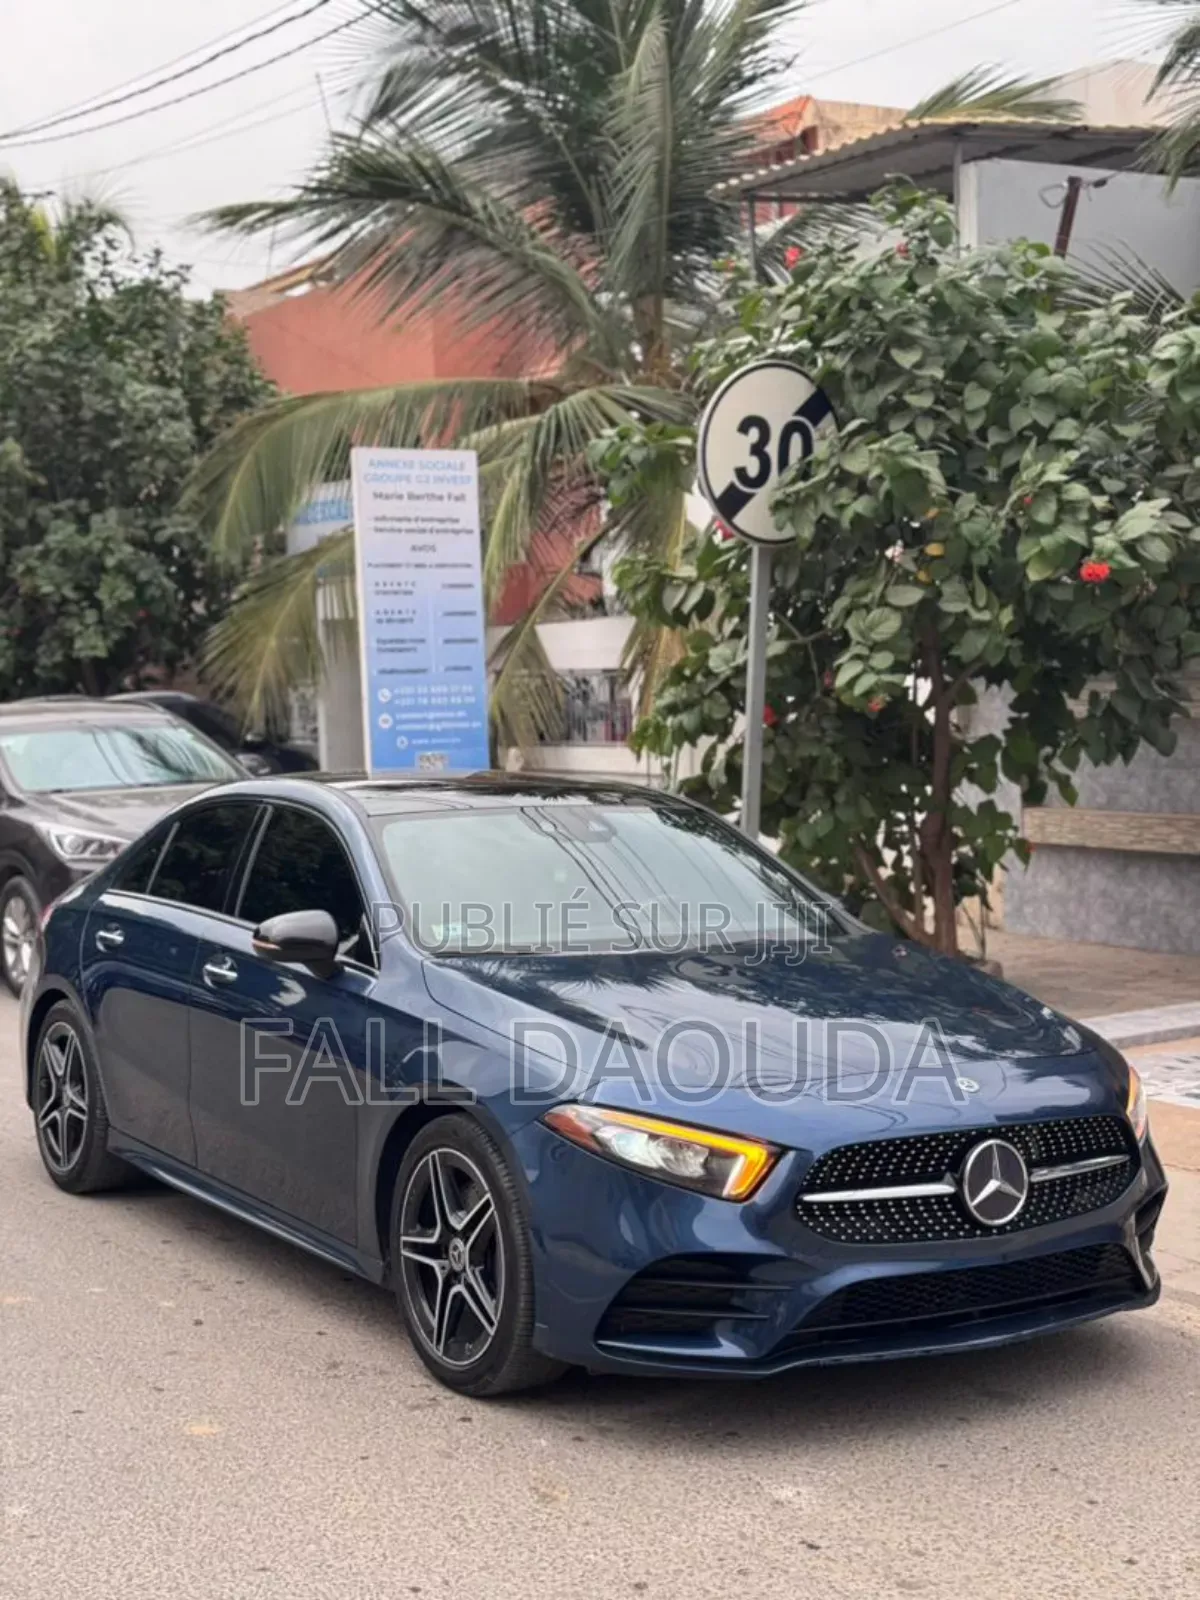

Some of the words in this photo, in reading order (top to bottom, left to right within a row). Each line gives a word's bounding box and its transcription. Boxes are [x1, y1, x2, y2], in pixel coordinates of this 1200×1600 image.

[733, 414, 814, 489] 30
[418, 459, 466, 471] SOCIALE
[372, 491, 404, 501] Marie
[407, 491, 444, 502] Berthe
[446, 492, 467, 502] Fall
